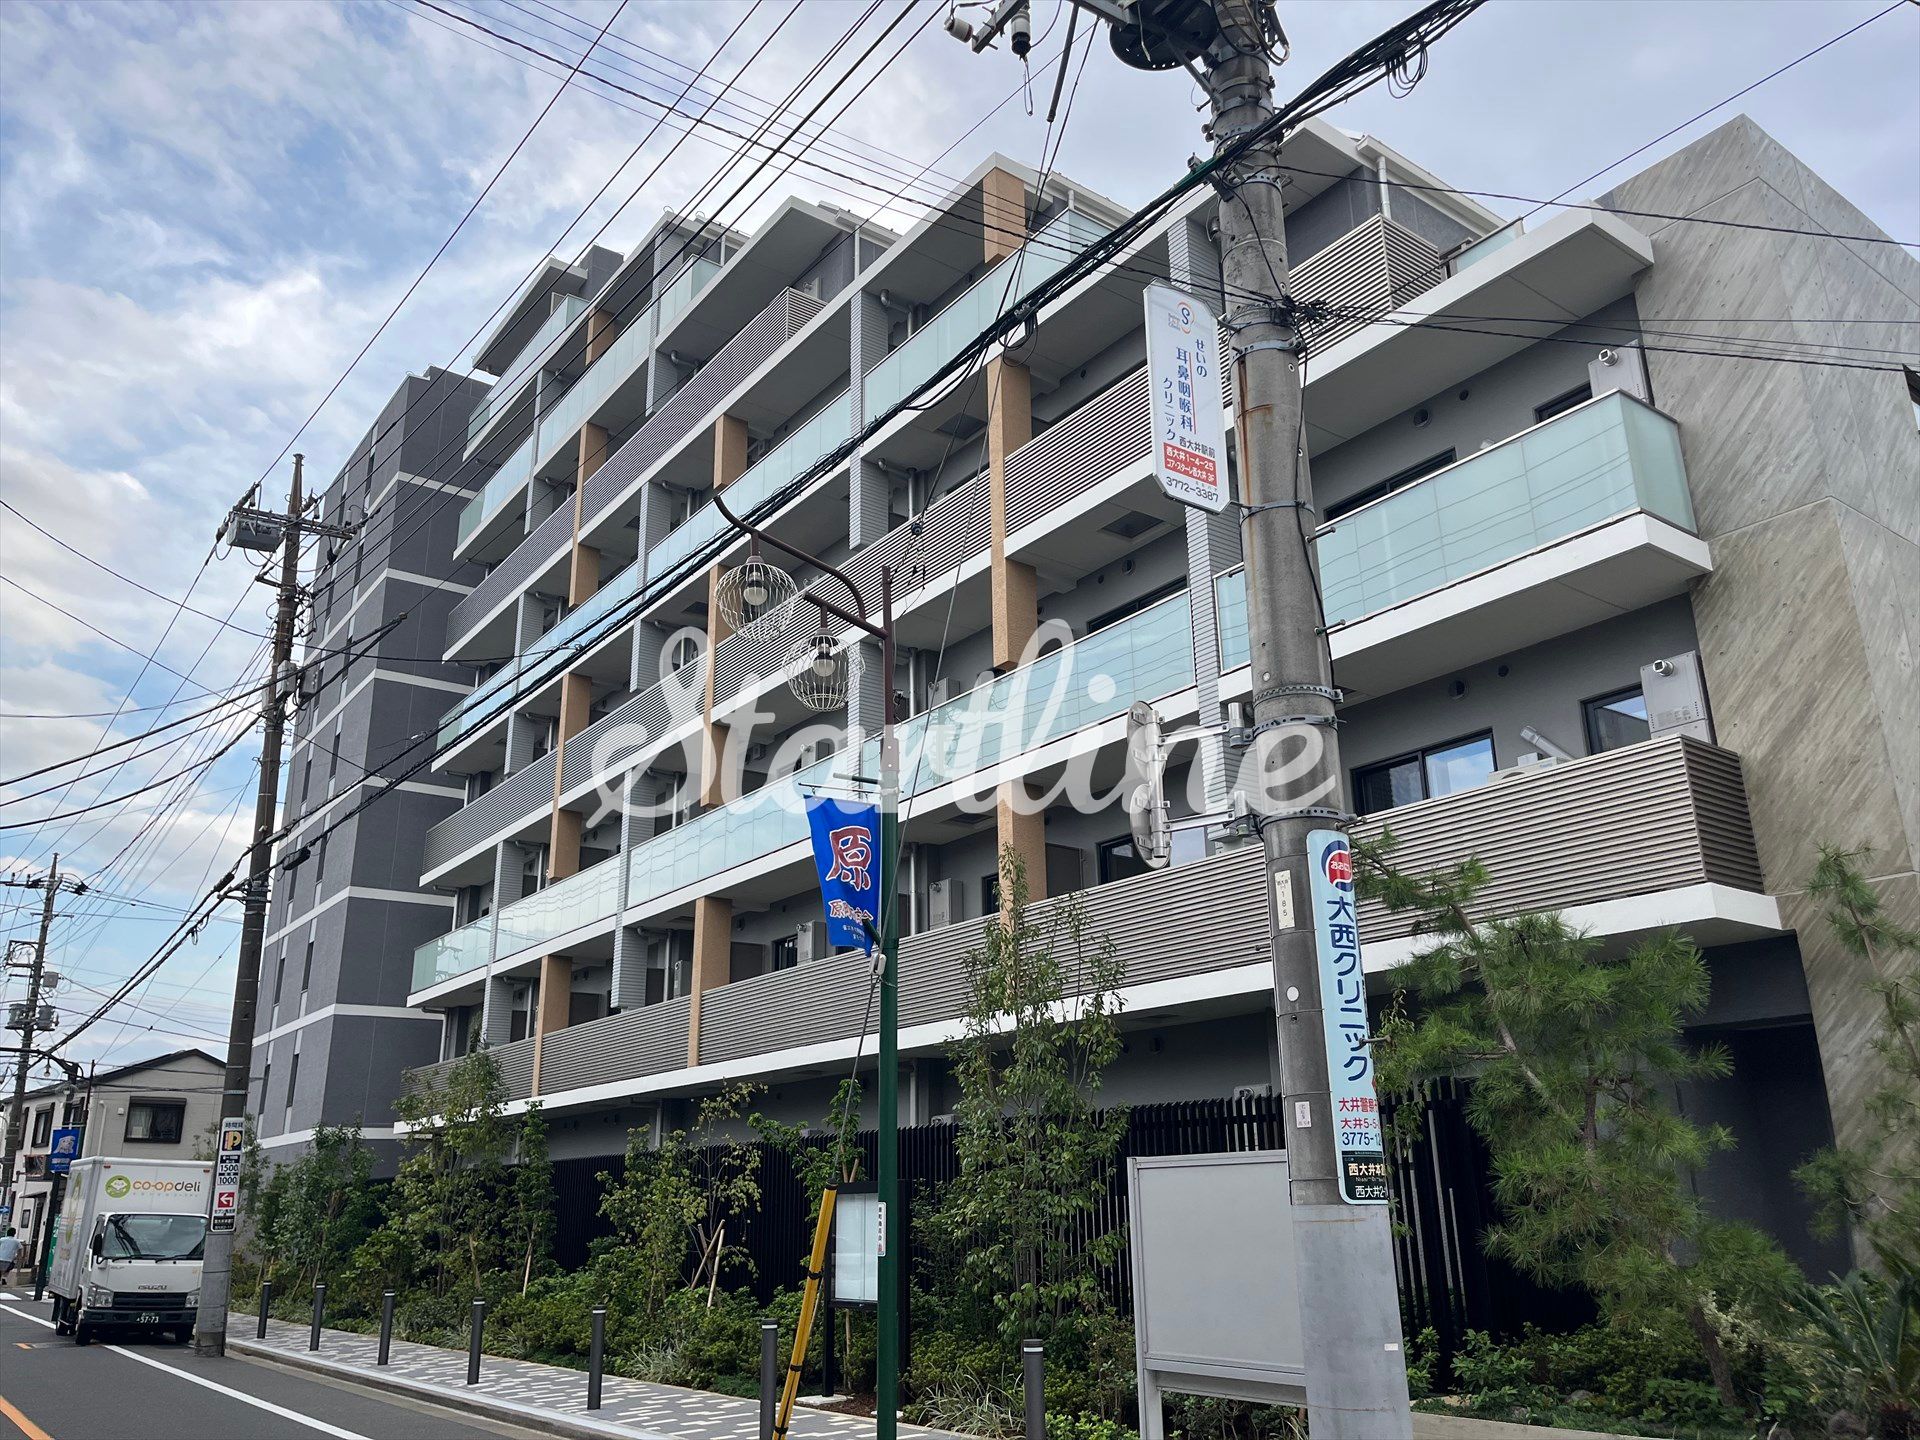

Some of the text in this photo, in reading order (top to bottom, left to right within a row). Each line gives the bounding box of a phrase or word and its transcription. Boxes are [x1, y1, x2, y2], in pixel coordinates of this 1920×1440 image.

[1195, 338, 1208, 378] せいの
[1162, 377, 1176, 441] クリニック
[1175, 346, 1193, 433] 耳鼻咽喉科
[1166, 476, 1219, 502] 3772-3387
[825, 825, 872, 892] 原
[1326, 896, 1369, 1081] 大西クリニック
[218, 1176, 238, 1185] 1000
[220, 1164, 239, 1172] 1500
